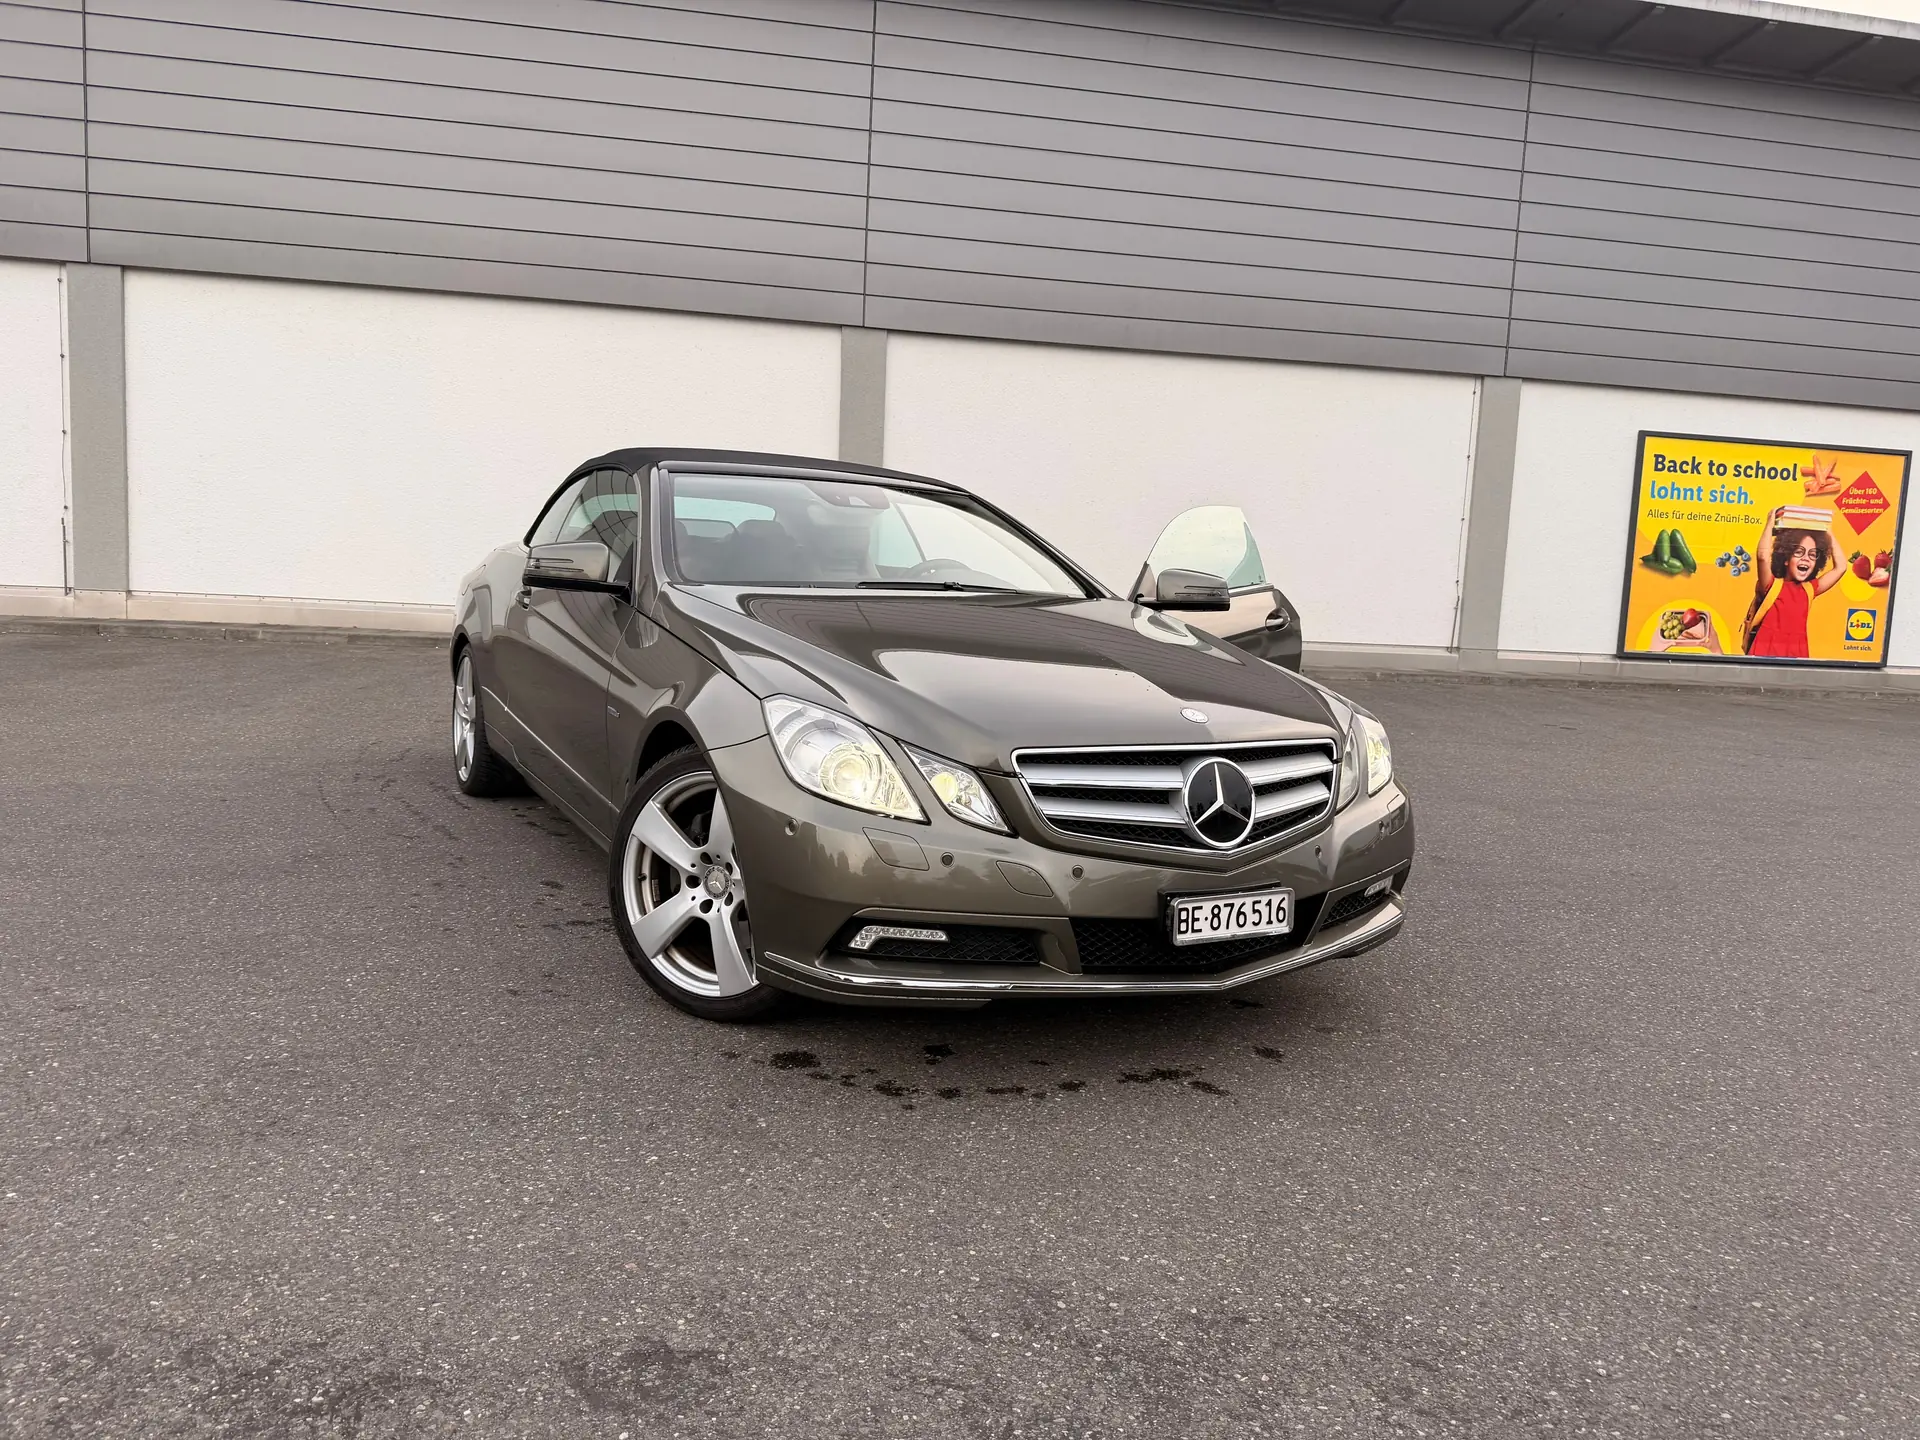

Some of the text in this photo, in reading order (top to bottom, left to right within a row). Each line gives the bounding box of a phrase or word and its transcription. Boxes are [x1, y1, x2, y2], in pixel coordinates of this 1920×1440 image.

[1653, 453, 1798, 482] Back to school
[1650, 480, 1754, 505] lohnt sich.
[1849, 486, 1865, 495] Über
[1647, 508, 1763, 525] Alles für deine Znüni-Box.
